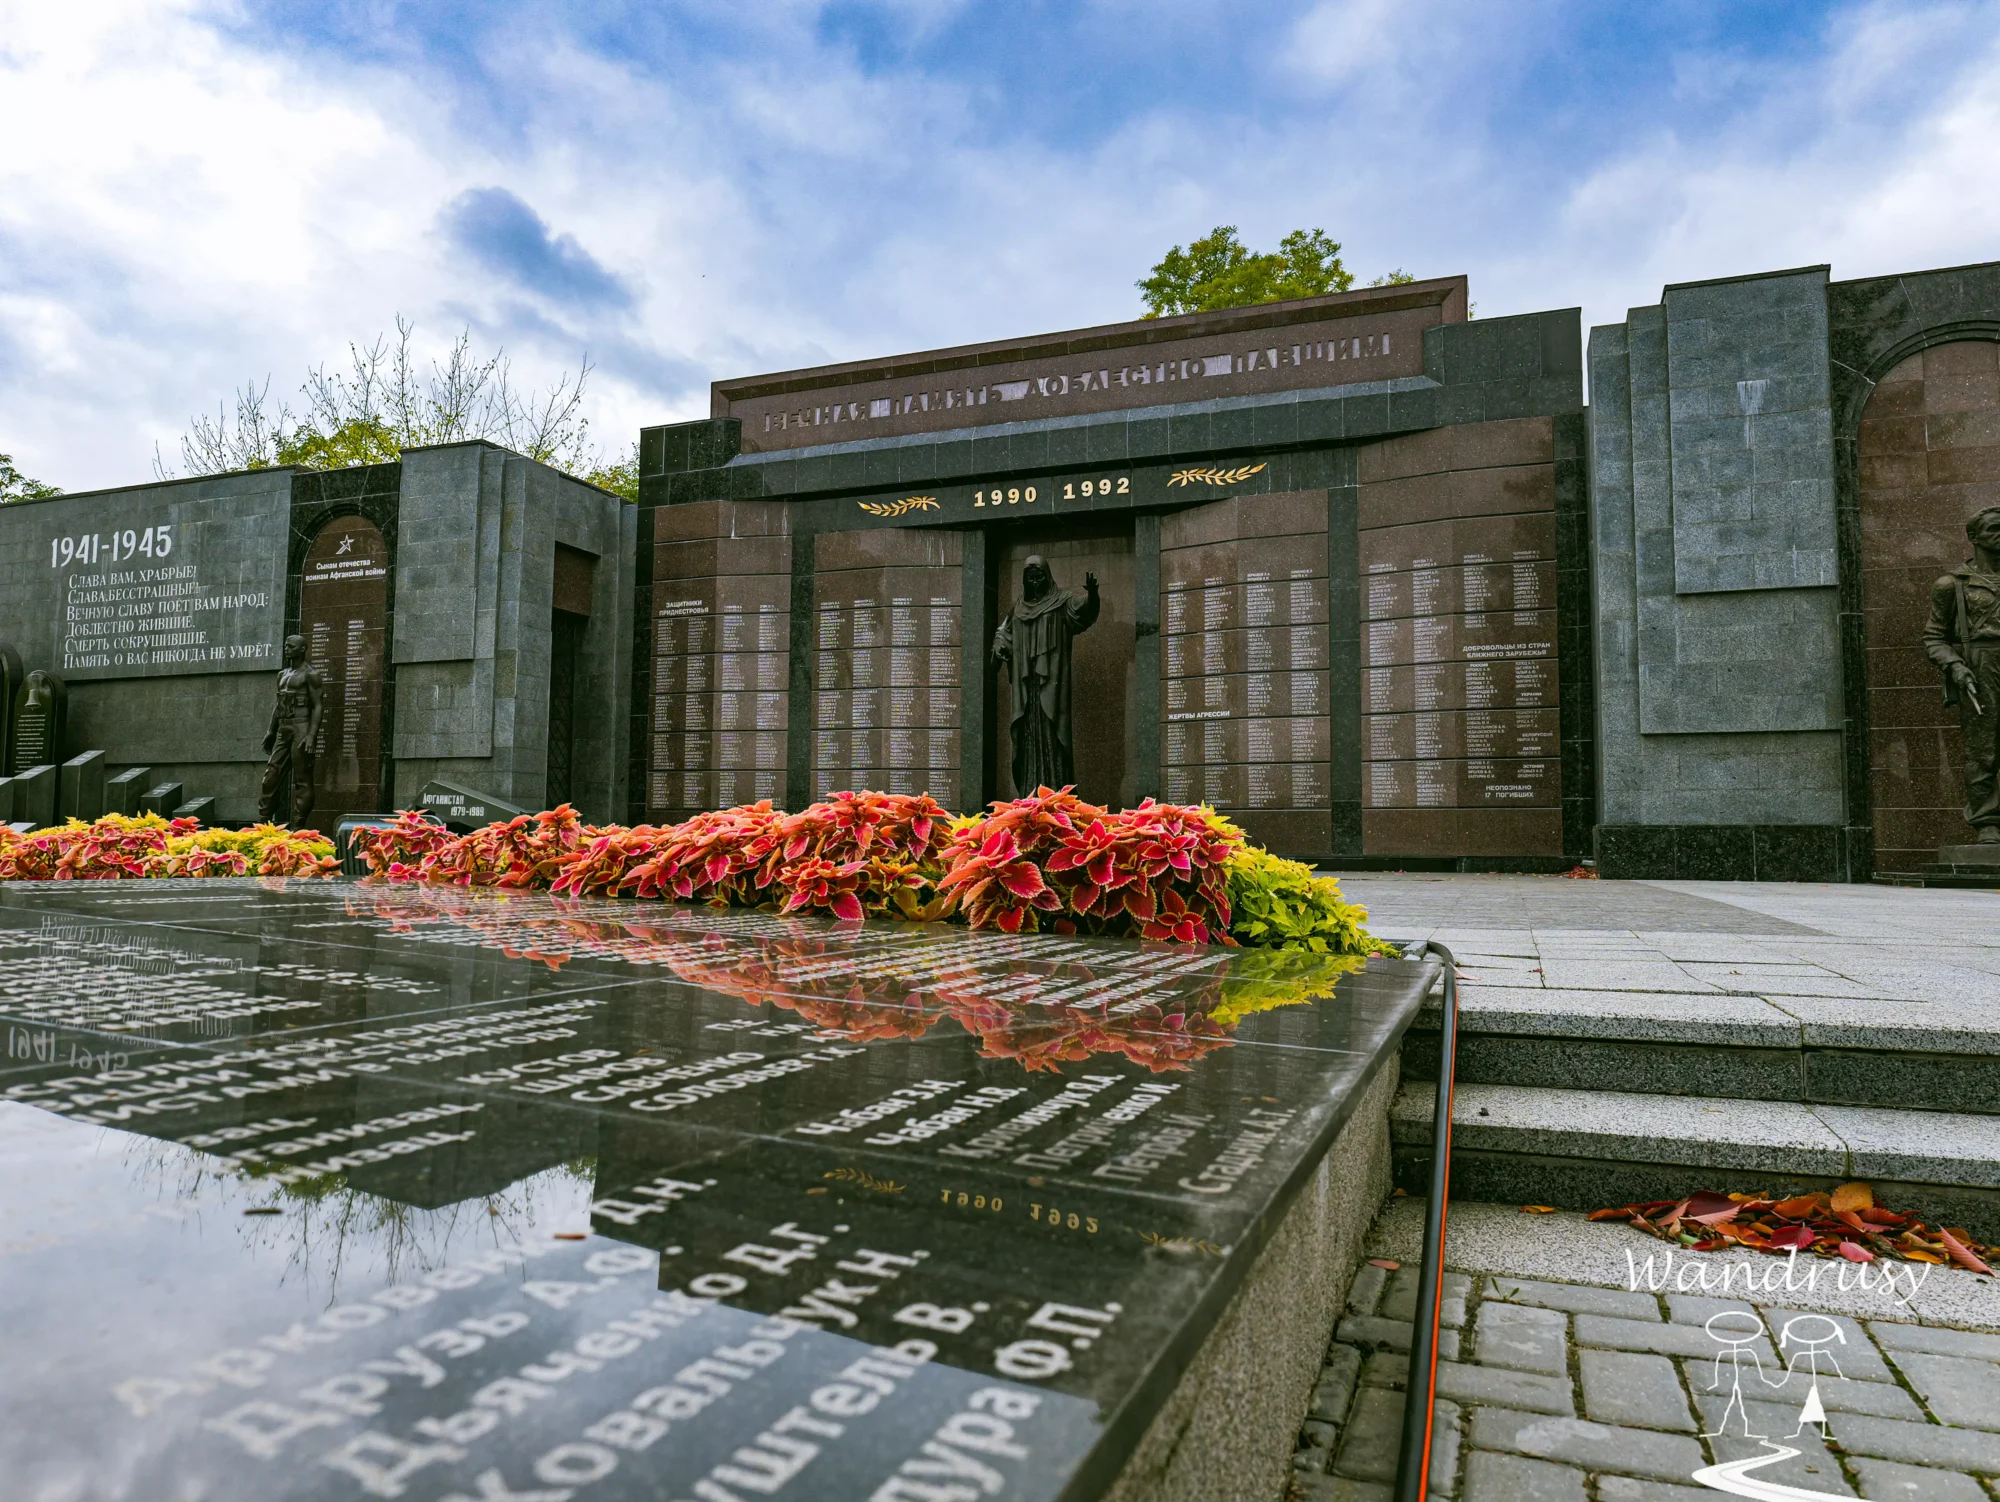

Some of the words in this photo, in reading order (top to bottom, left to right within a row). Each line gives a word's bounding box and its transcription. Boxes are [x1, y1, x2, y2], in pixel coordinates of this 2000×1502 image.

[763, 401, 867, 433] ВЕЧНАЯ
[1027, 356, 1205, 398] ДОБЛЕСТНО
[973, 486, 1038, 508] 1990
[1063, 477, 1131, 501] 1992
[51, 524, 173, 569] 1941-1945
[1462, 644, 1516, 653] ДОБРОВОЛЬЦЫ
[1528, 642, 1552, 650] СТРАН
[1466, 651, 1504, 659] БЛИЖНЕГО
[1505, 650, 1547, 658] ЗАРУБЕЖЬЯ
[1168, 712, 1196, 720] ЖЕРТВЫ
[1196, 710, 1230, 719] АГРЕССИИ
[1495, 791, 1535, 799] ПОГИБШИХ
[455, 1047, 621, 1087] КУСТОВ
[509, 1055, 668, 1094] ШАРОВ
[570, 1050, 766, 1103] САВЧЕНКО
[795, 1098, 918, 1136] Чабан
[863, 1106, 982, 1146] Чабан
[955, 1085, 1029, 1108] Н.В.
[1091, 1125, 1197, 1183] Петров
[1178, 1129, 1278, 1194] Стадник
[589, 1176, 719, 1226] Д.Н.
[836, 1248, 931, 1279] Н.
[891, 1302, 992, 1335] В.
[993, 1300, 1124, 1379] Ф.П.
[202, 1308, 531, 1459] Друзь
[519, 1245, 686, 1309] А.Ф.
[317, 1271, 749, 1499] Дьяченко
